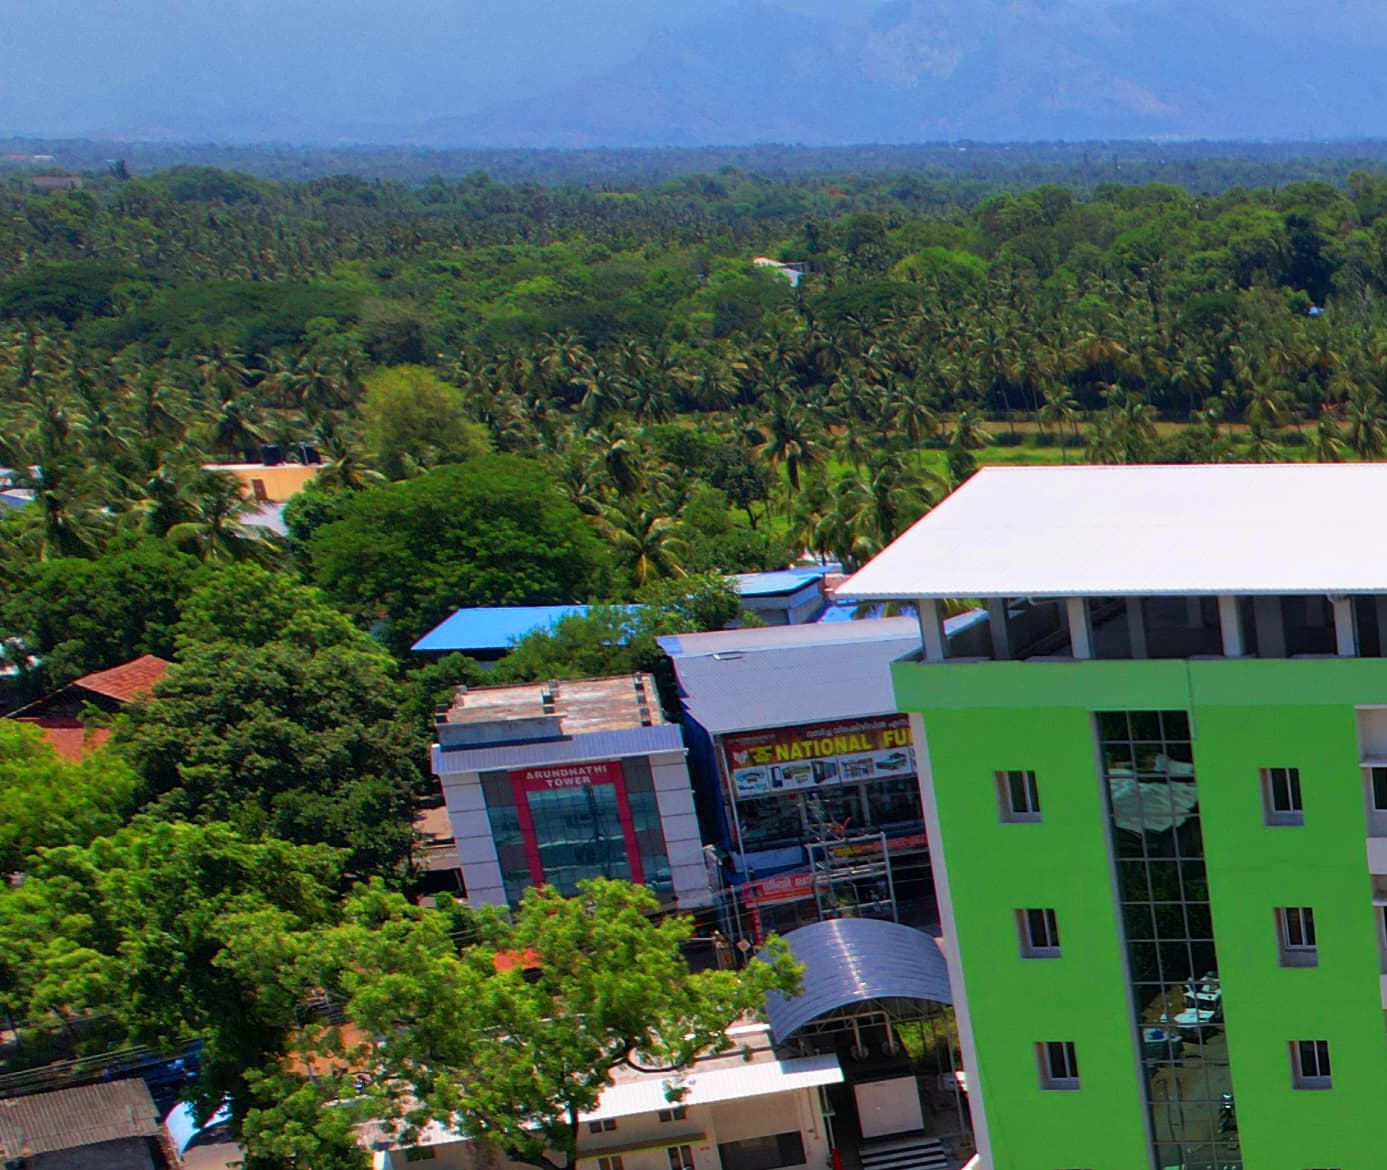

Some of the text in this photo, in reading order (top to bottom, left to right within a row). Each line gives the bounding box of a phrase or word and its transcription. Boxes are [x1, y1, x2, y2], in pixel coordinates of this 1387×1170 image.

[776, 733, 873, 762] NATIONAL
[883, 727, 913, 749] FU
[546, 775, 592, 788] TOWER
